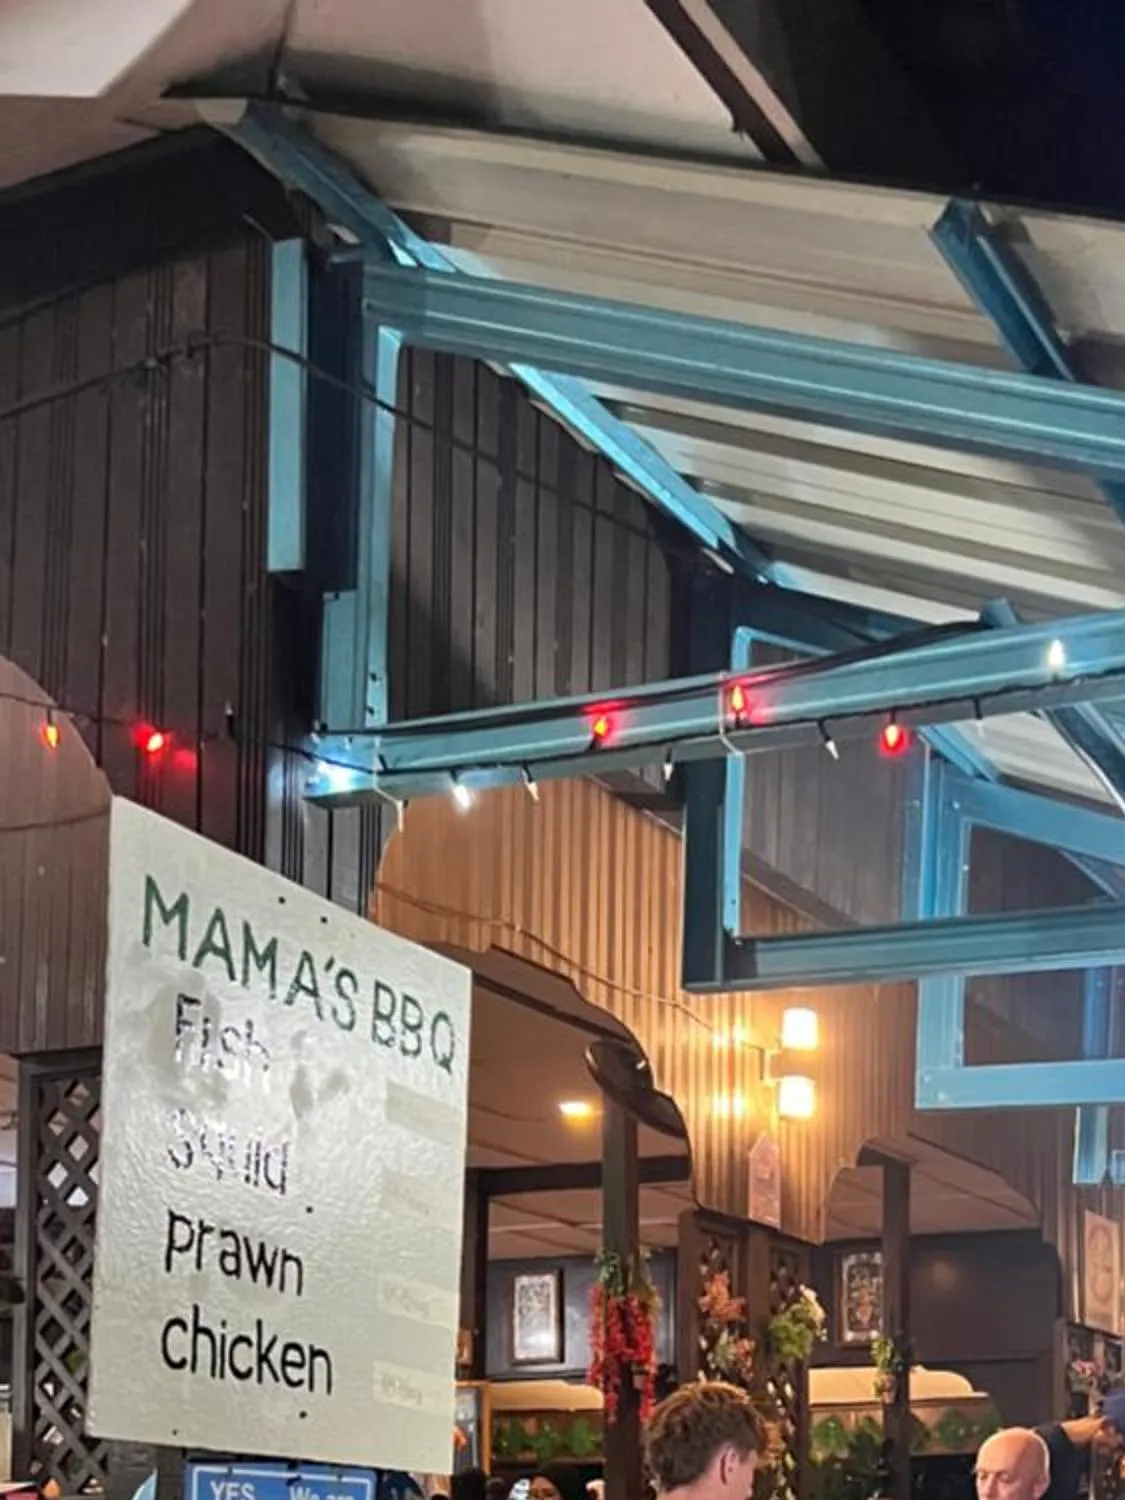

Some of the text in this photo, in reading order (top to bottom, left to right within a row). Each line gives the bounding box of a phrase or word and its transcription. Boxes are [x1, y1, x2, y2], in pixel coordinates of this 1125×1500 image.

[142, 874, 456, 1074] MAMA'S BBQ
[164, 1208, 304, 1297] prawn
[161, 1303, 333, 1396] chicken
